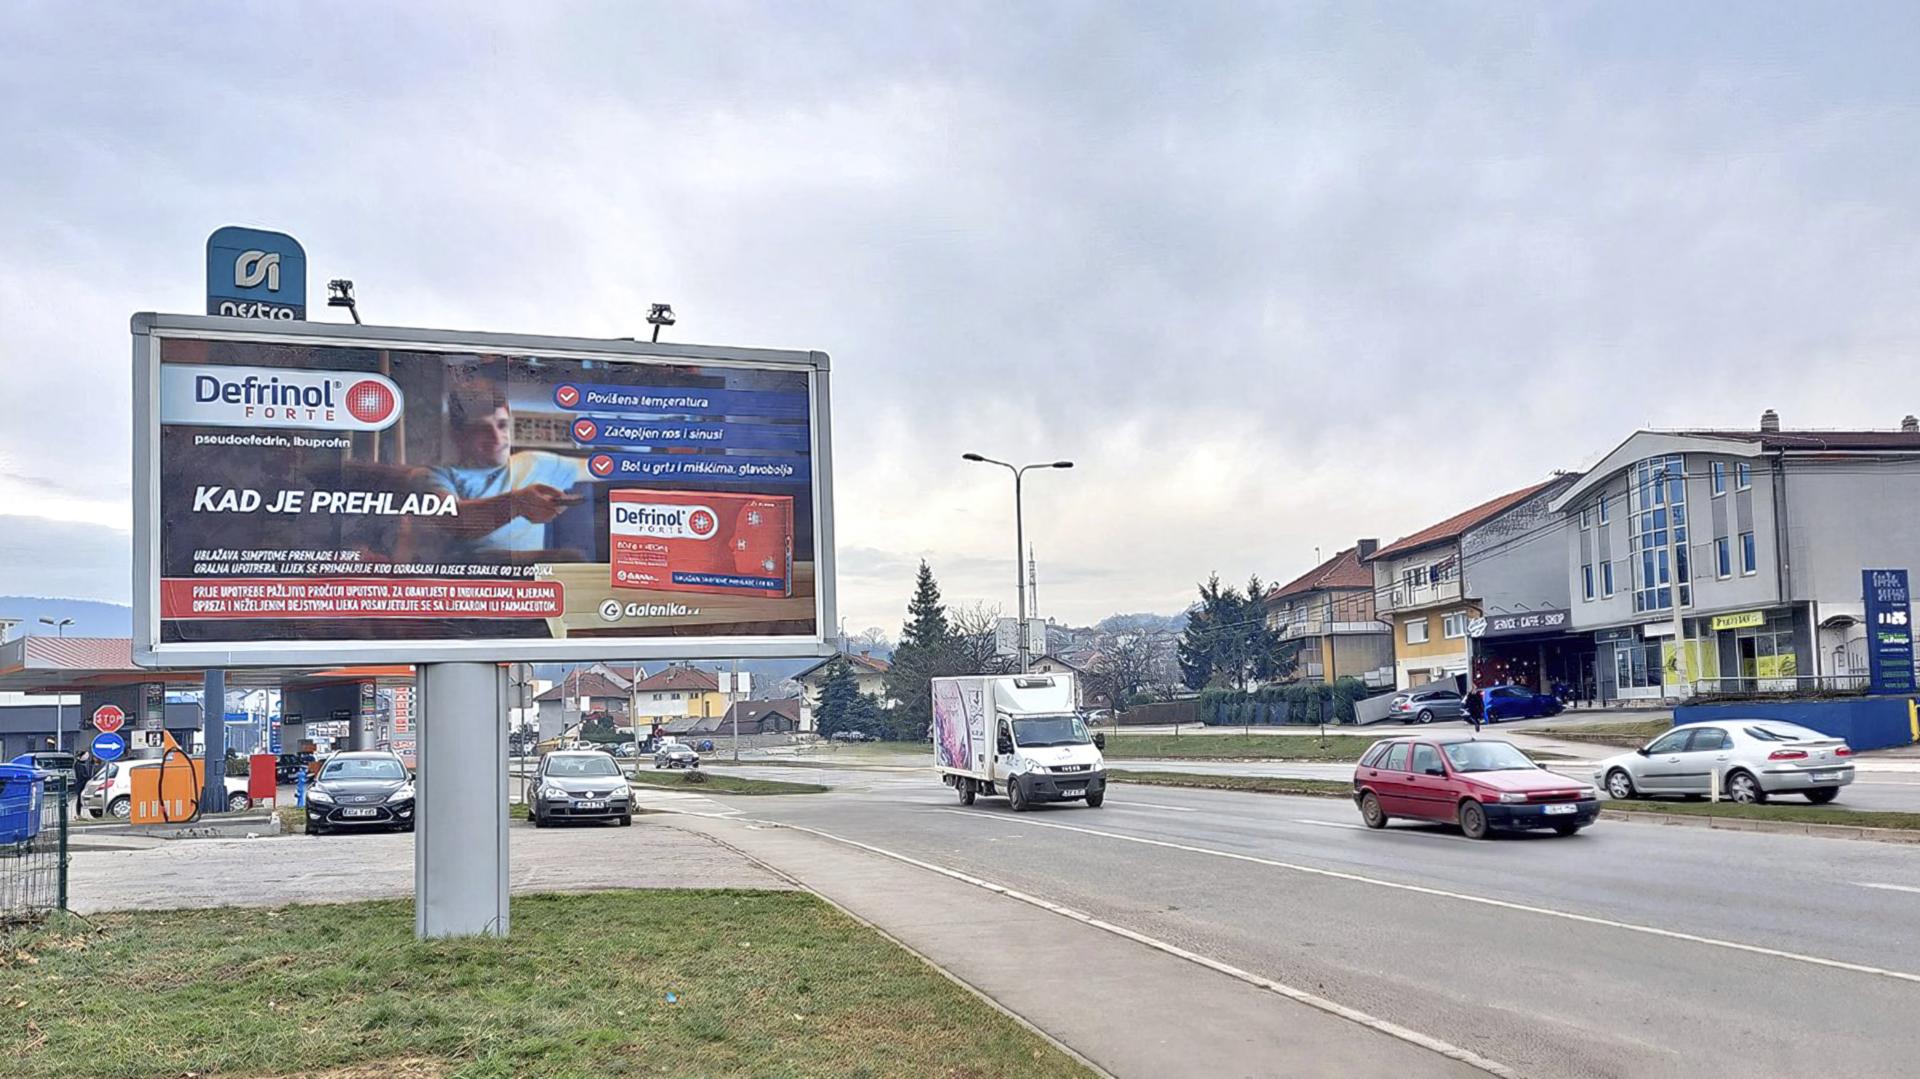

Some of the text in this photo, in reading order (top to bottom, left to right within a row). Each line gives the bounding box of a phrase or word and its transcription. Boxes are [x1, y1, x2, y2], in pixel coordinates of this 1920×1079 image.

[195, 375, 334, 408] Defrinol
[587, 391, 709, 409] Povišena temperatura
[246, 406, 335, 421] FORTE
[604, 424, 659, 440] Začepljen
[661, 429, 681, 440] nos
[689, 428, 724, 441] sinusi
[620, 460, 641, 472] Bol
[642, 463, 651, 473] u
[738, 464, 793, 477] glavobolja
[192, 486, 459, 516] KAD JE PREHLADA
[615, 507, 683, 526] Defrinol
[241, 550, 287, 561] SIMPTOME
[287, 550, 333, 561] PREHLADE
[306, 563, 318, 574] SE
[440, 564, 466, 575] DJECE
[193, 585, 219, 598] PRIJE
[220, 585, 265, 598] UPOTREBE
[392, 586, 403, 598] ZA
[420, 600, 431, 612] SE
[432, 600, 444, 612] SA
[624, 602, 687, 617] Galenika
[96, 713, 124, 725] STOP
